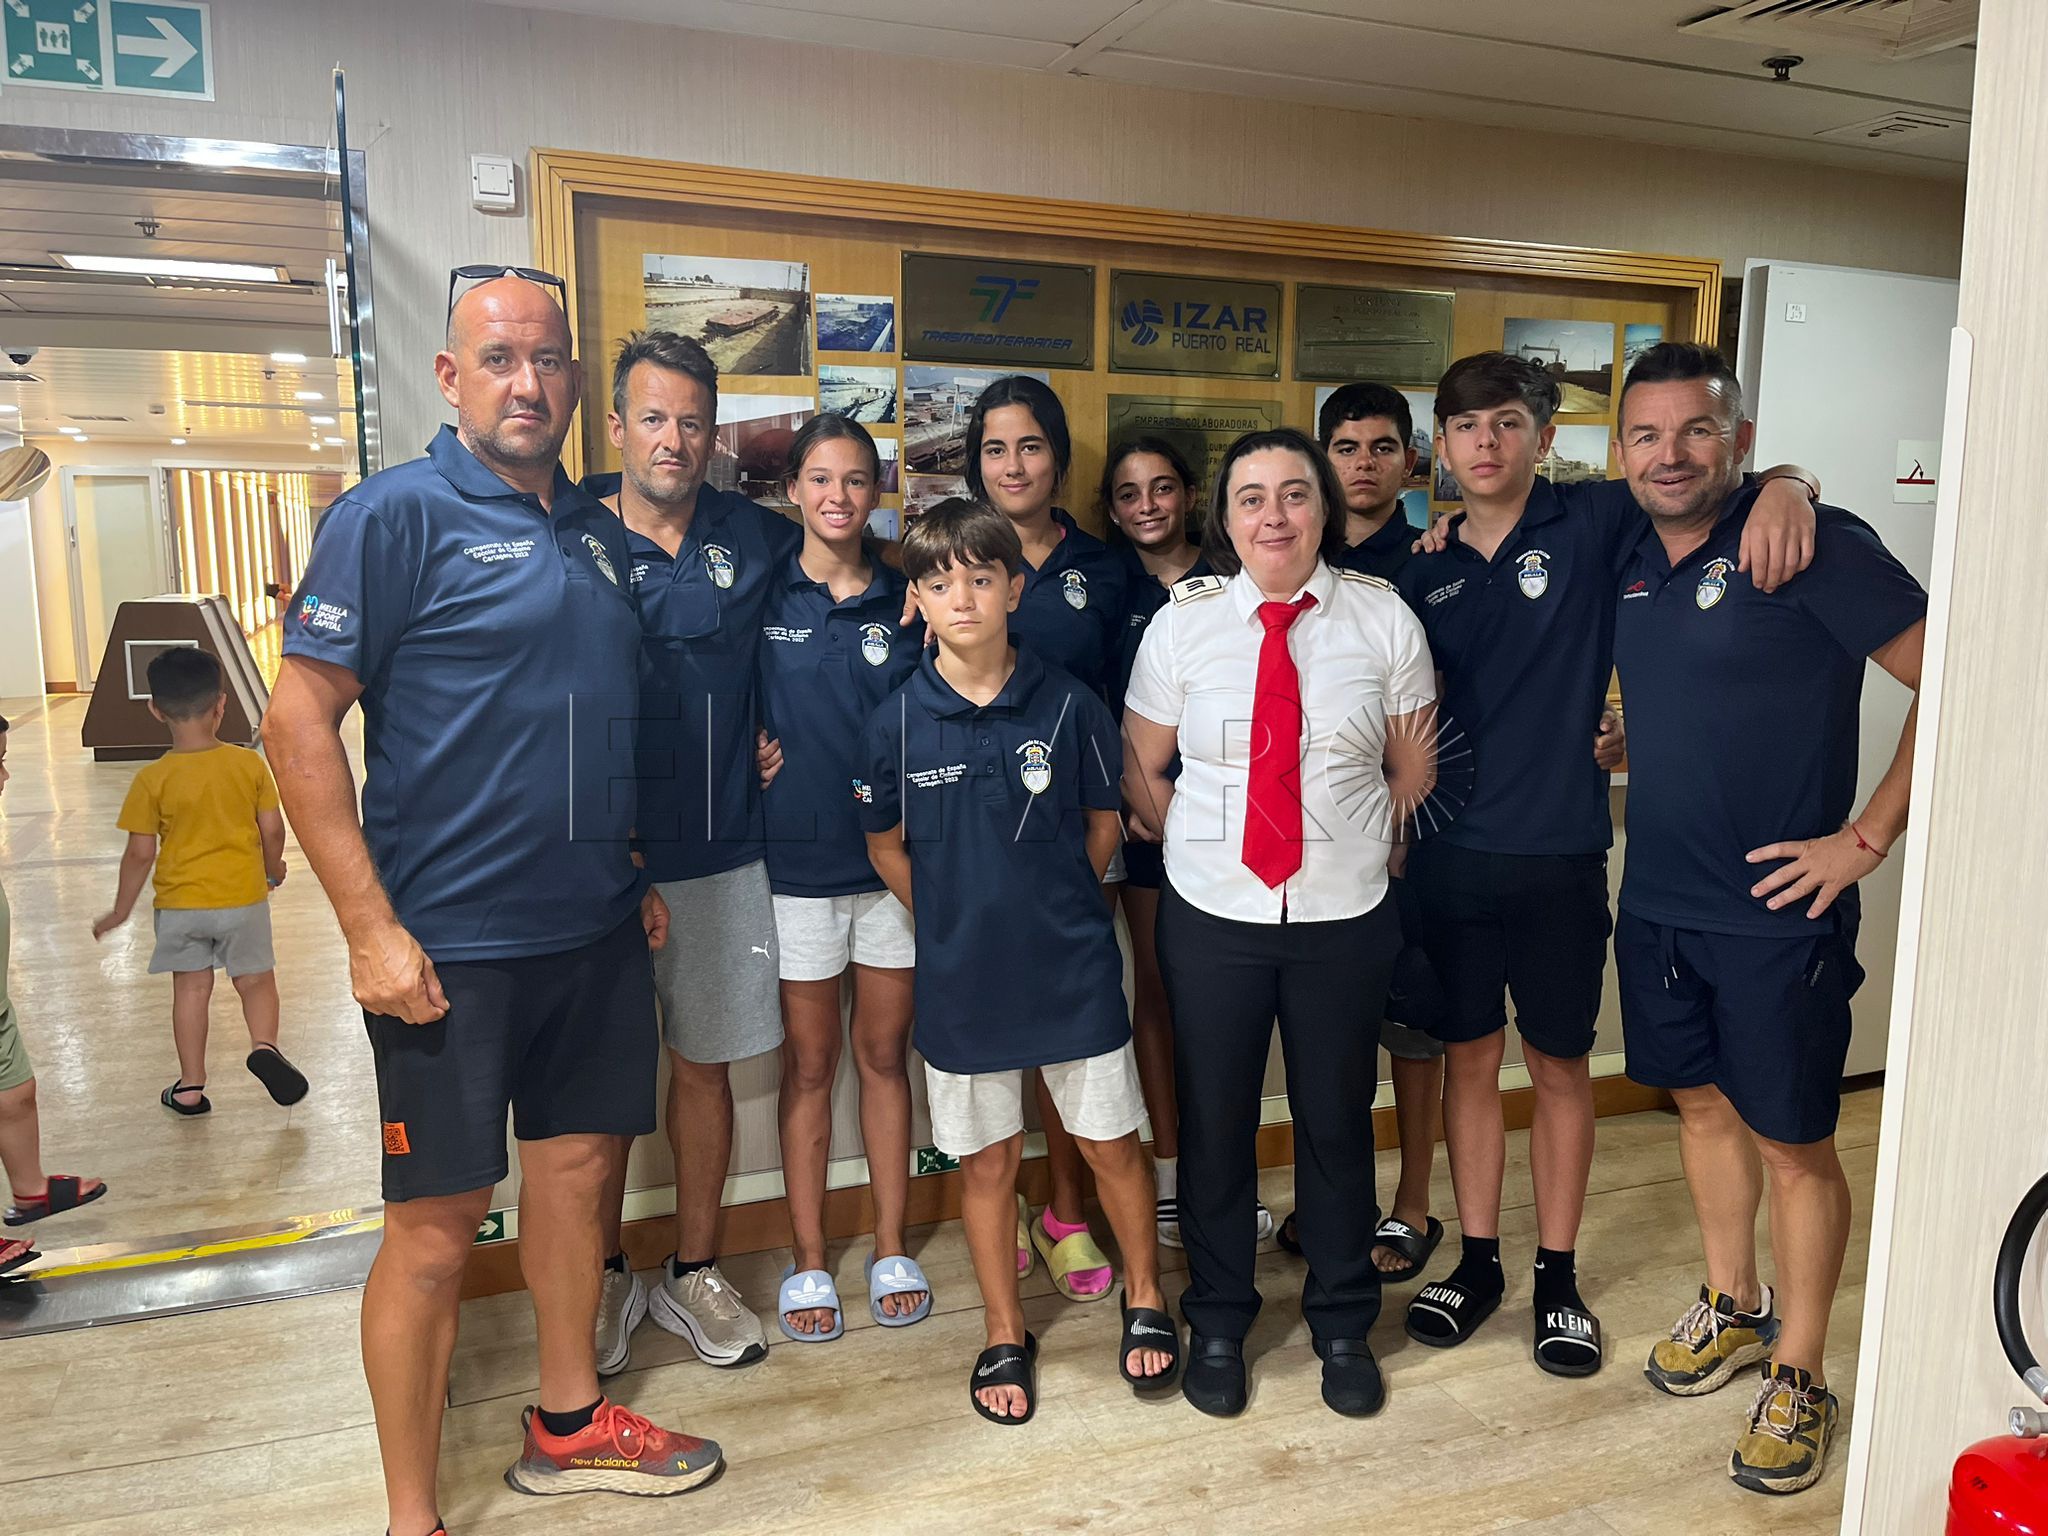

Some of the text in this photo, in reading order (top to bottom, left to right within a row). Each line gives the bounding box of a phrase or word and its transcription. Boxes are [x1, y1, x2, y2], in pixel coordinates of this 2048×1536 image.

[1172, 302, 1268, 334] IZAR
[922, 330, 1073, 349] TRASMEDITERRANEA
[1172, 333, 1272, 354] PUERTO REAL
[1134, 415, 1258, 430] EMPRESAS COLABORADORAS
[315, 610, 341, 622] SPORT
[319, 602, 348, 618] MELILLA
[312, 618, 342, 632] CAPITAL
[1382, 1220, 1410, 1234] NIKE
[1420, 1286, 1465, 1310] CALVIN
[1546, 1312, 1593, 1335] KLEIN
[570, 1457, 640, 1468] new balance
